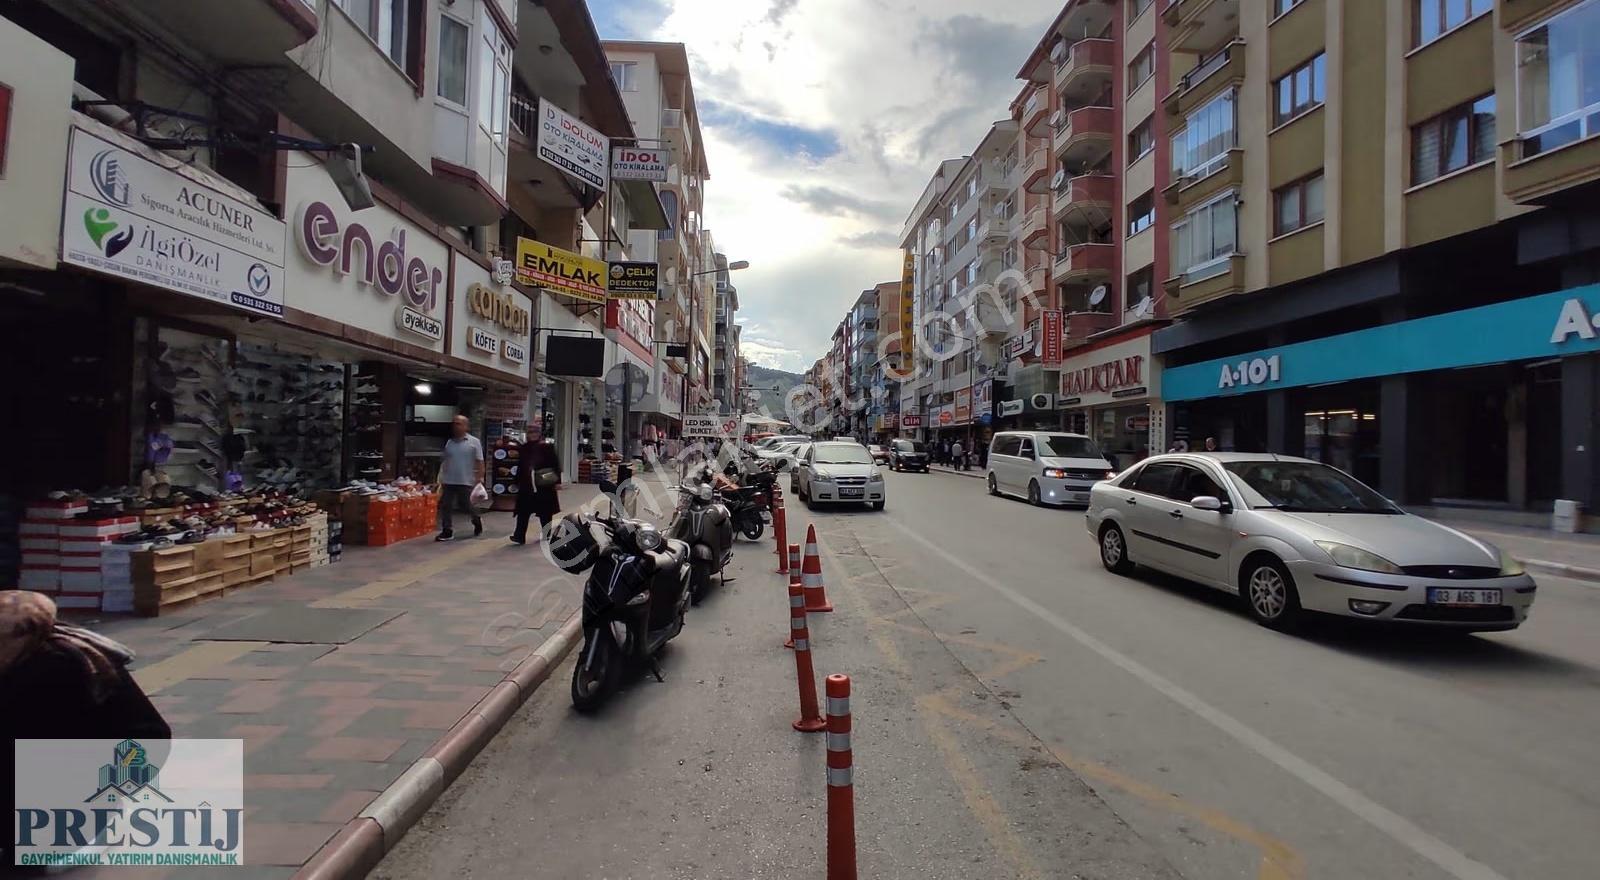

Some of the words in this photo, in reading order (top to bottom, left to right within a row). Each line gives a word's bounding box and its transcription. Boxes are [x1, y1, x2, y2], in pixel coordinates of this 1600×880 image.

[543, 122, 562, 137] OTO
[562, 131, 604, 161] KİRALAMA
[560, 115, 604, 150] İDOLÜM
[613, 162, 628, 170] OTO
[629, 162, 665, 172] KİRALAMA
[620, 149, 660, 163] İDOL
[140, 193, 175, 214] Sigorta
[177, 209, 211, 228] Aracılık
[176, 187, 254, 232] ACUNER
[297, 201, 443, 310] ender
[523, 253, 601, 286] EMLAK
[626, 267, 655, 278] ÇELİK
[405, 313, 440, 336] ayakkabı
[467, 282, 528, 337] candan
[475, 332, 496, 351] KÖFTE
[1062, 355, 1143, 395] HALKTAN
